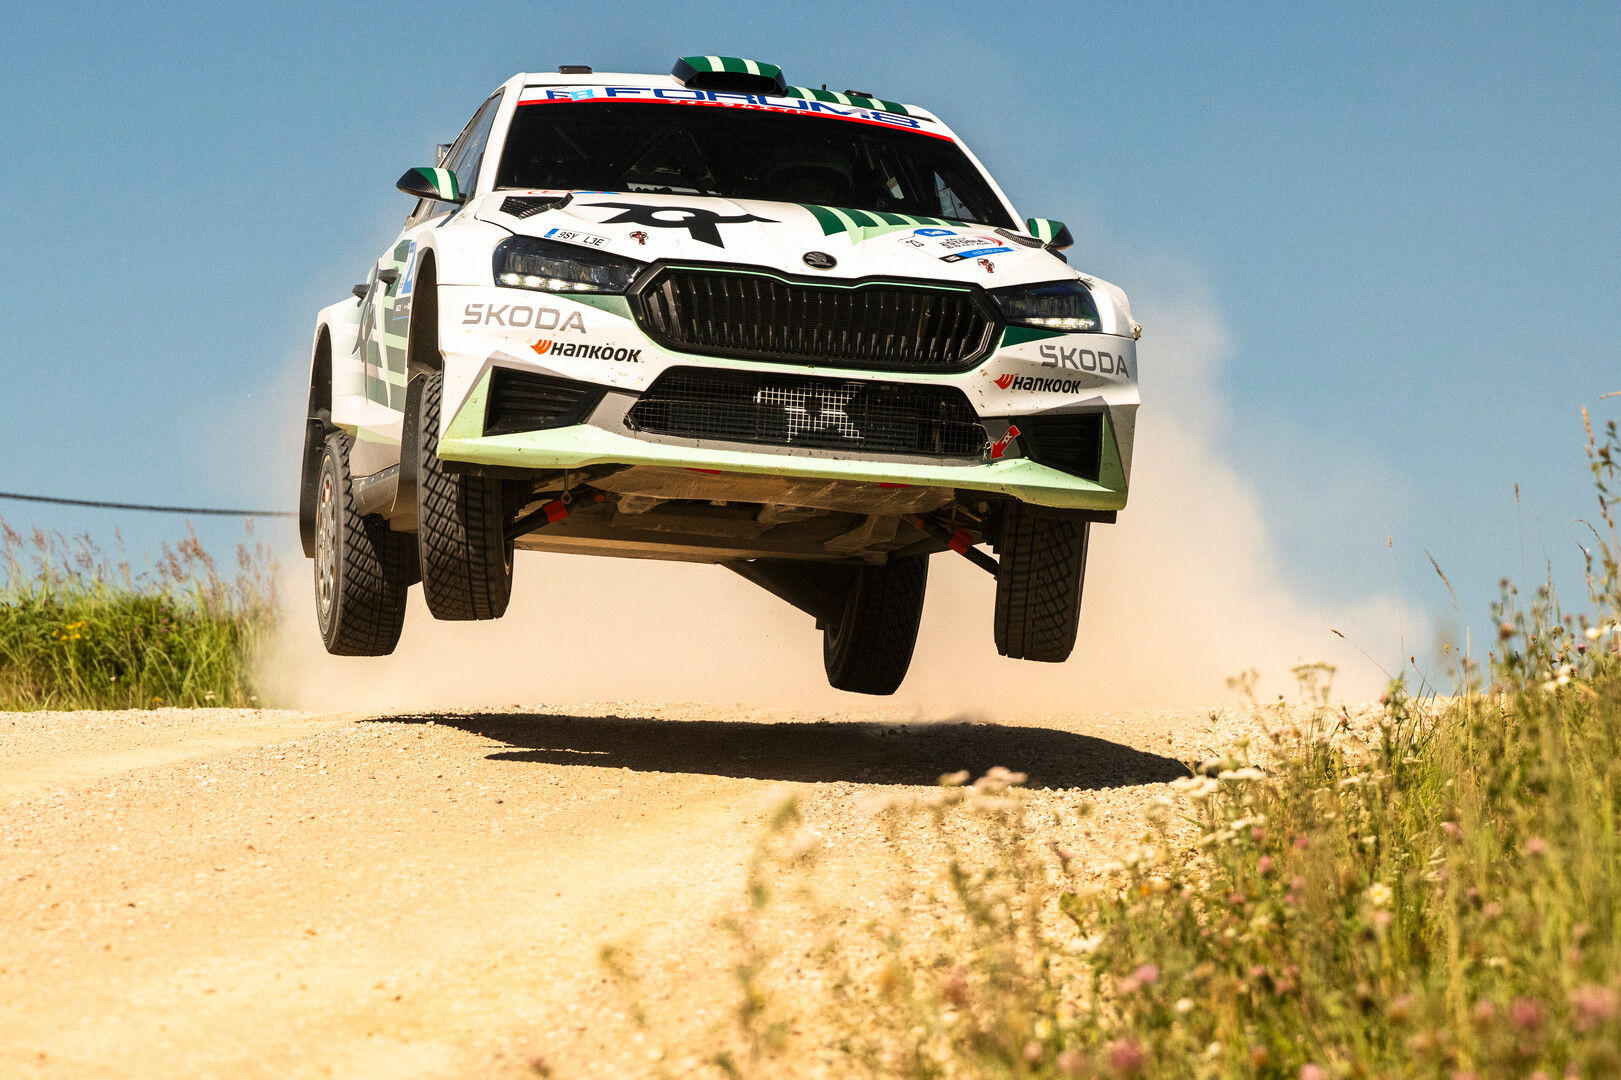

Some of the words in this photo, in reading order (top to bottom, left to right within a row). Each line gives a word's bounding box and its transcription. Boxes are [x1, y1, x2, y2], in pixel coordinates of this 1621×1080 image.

[604, 87, 921, 129] FORUM8
[557, 231, 579, 241] 9SY
[583, 235, 605, 247] L3E
